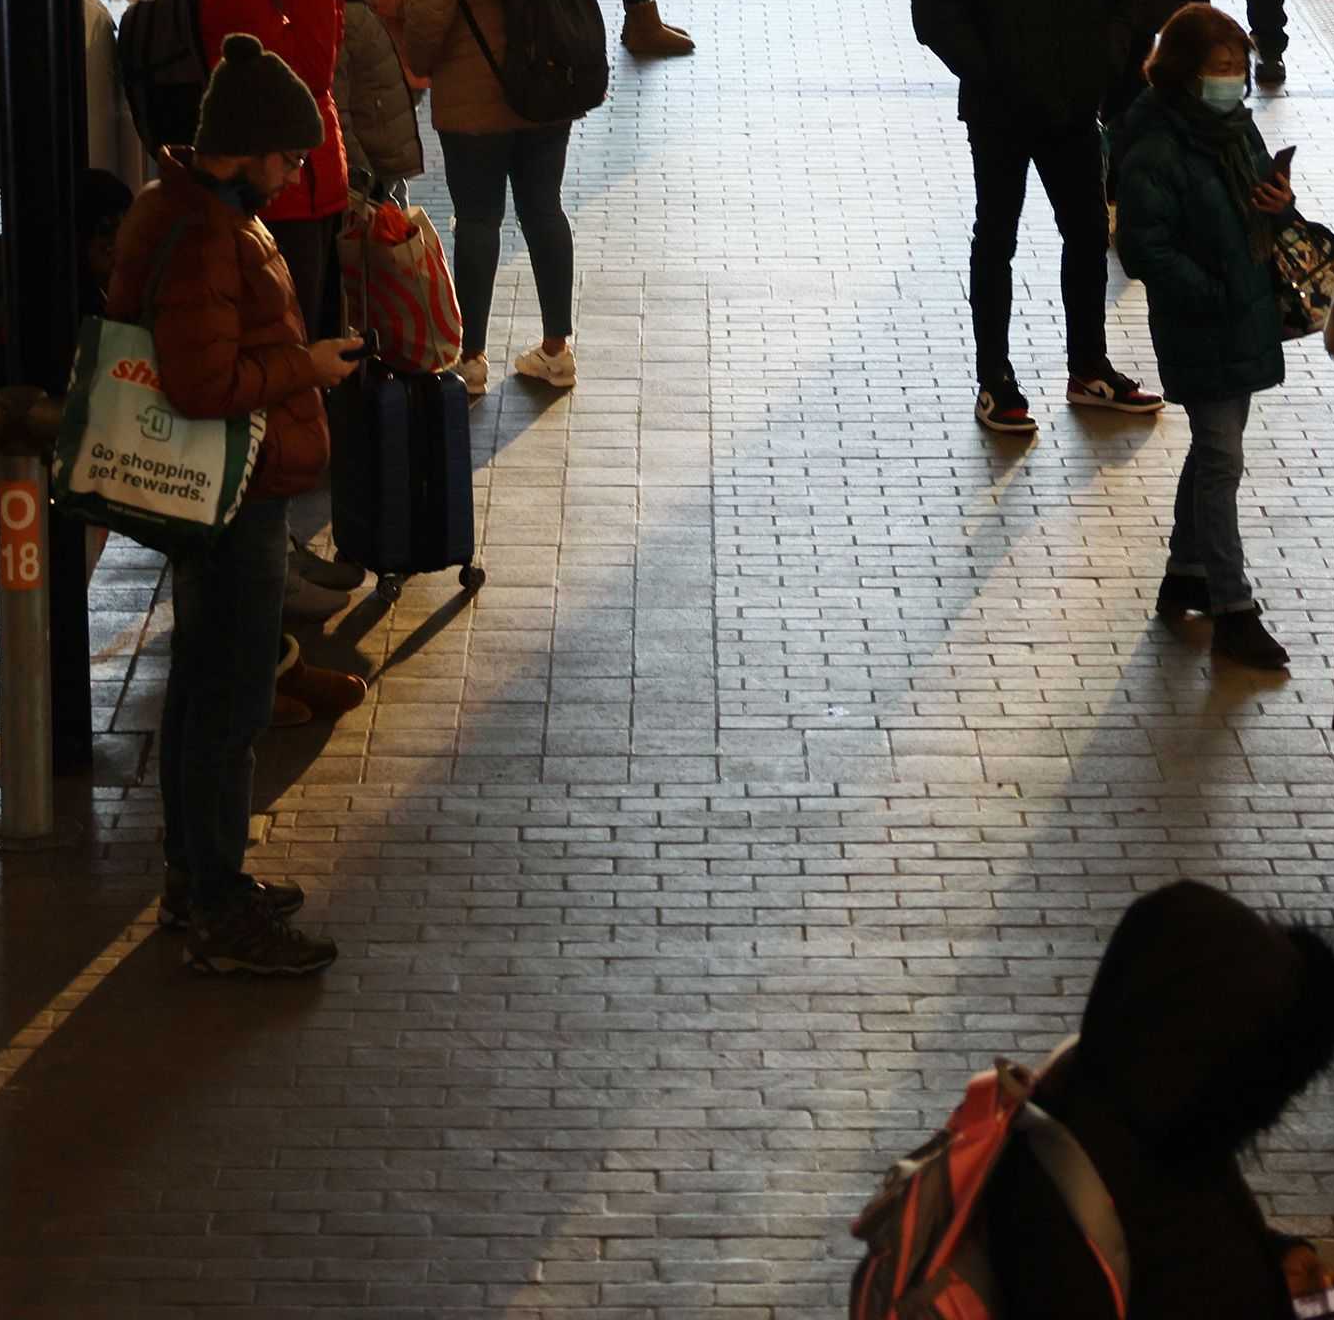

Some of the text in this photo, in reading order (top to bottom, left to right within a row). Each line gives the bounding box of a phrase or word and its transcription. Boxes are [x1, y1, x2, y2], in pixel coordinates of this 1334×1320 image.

[87, 464, 206, 503] get rewards.
[91, 442, 212, 489] Go shopping,
[1, 542, 41, 583] 18
